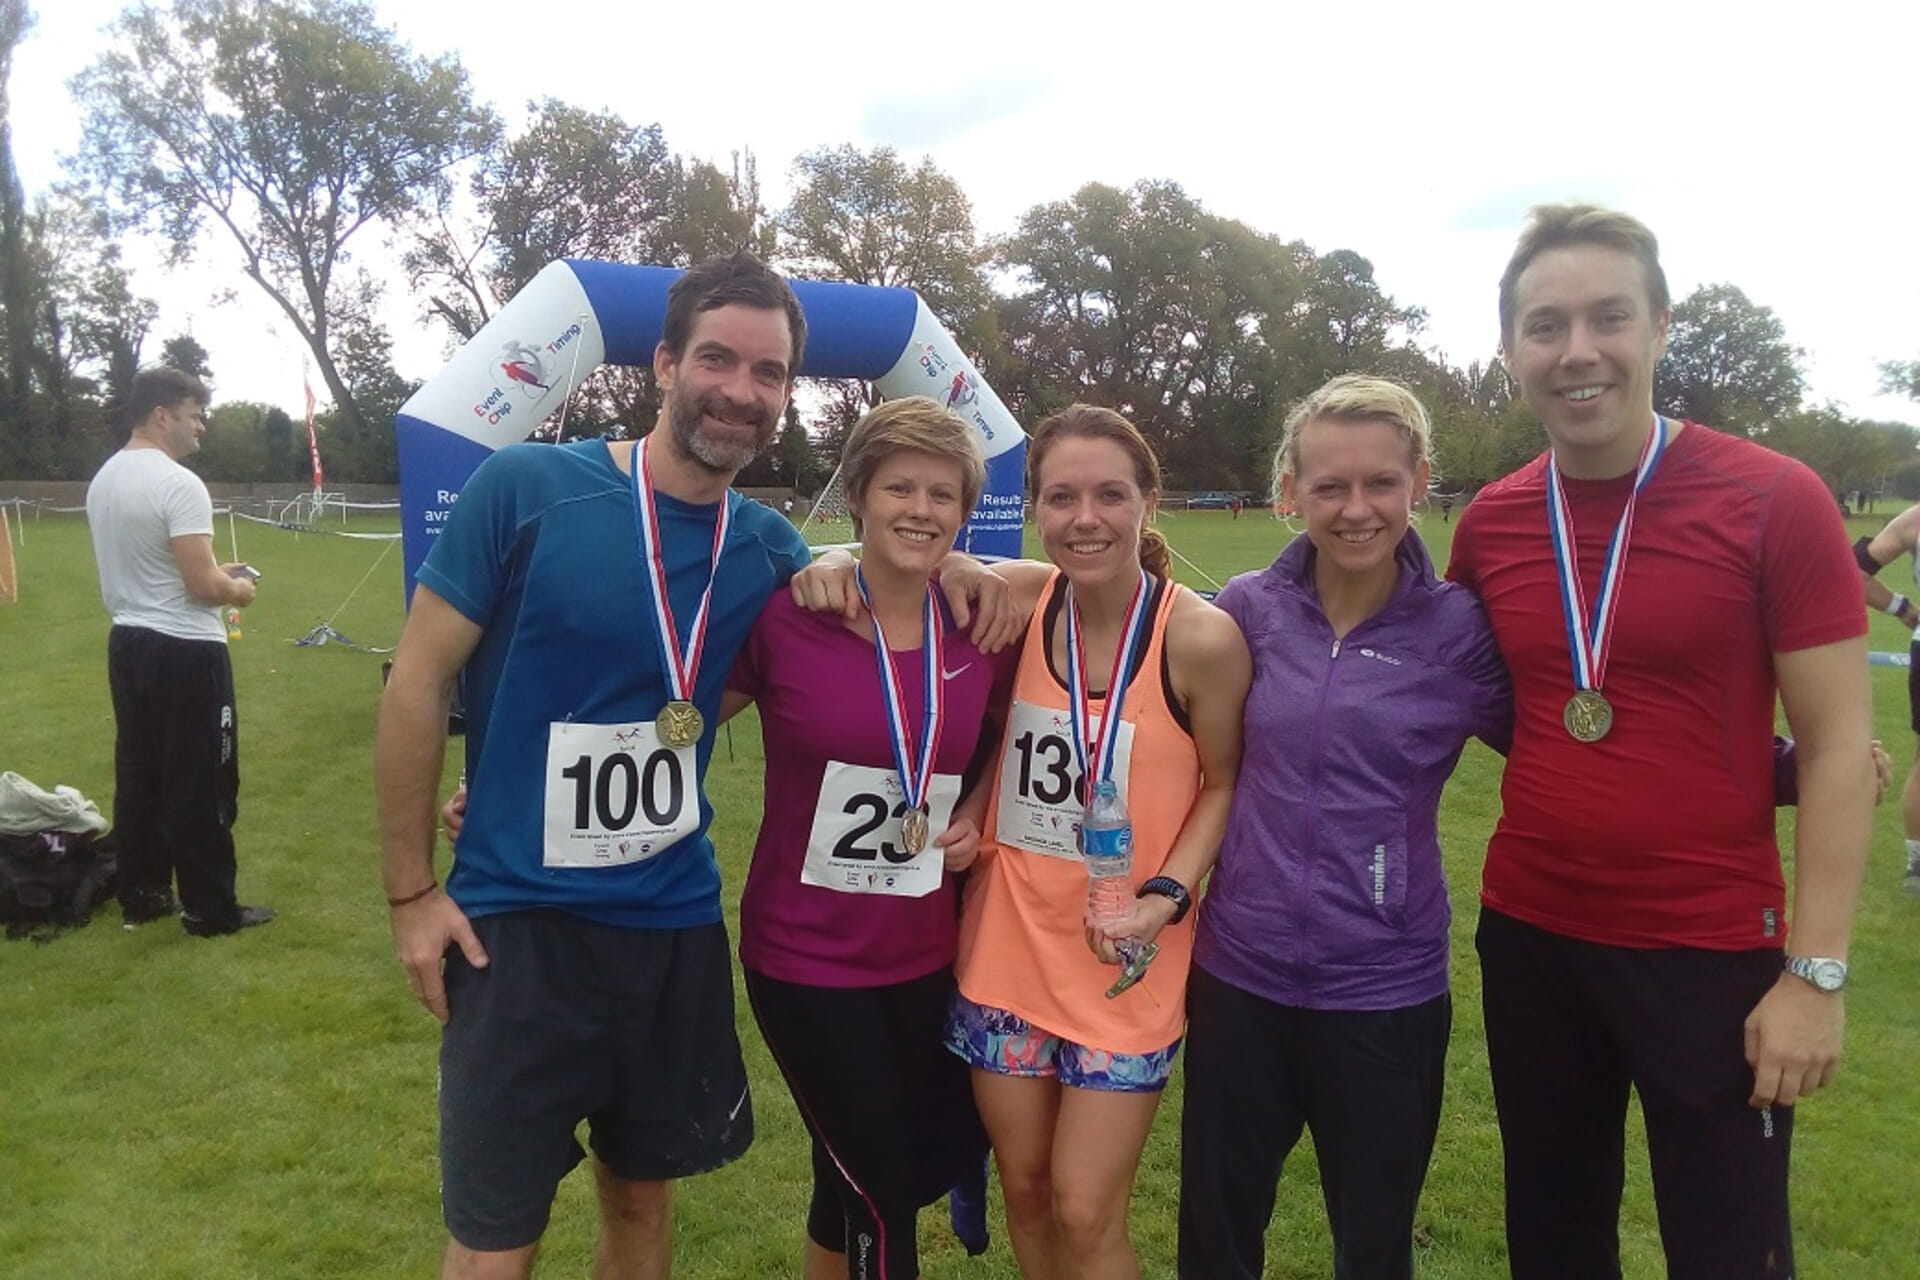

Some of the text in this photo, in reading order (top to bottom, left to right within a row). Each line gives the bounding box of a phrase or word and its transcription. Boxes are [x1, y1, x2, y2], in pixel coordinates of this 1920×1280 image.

[546, 323, 581, 355] Timing
[474, 387, 504, 417] Event
[488, 401, 512, 425] Chip
[562, 748, 683, 831] 100
[832, 793, 930, 864] 23
